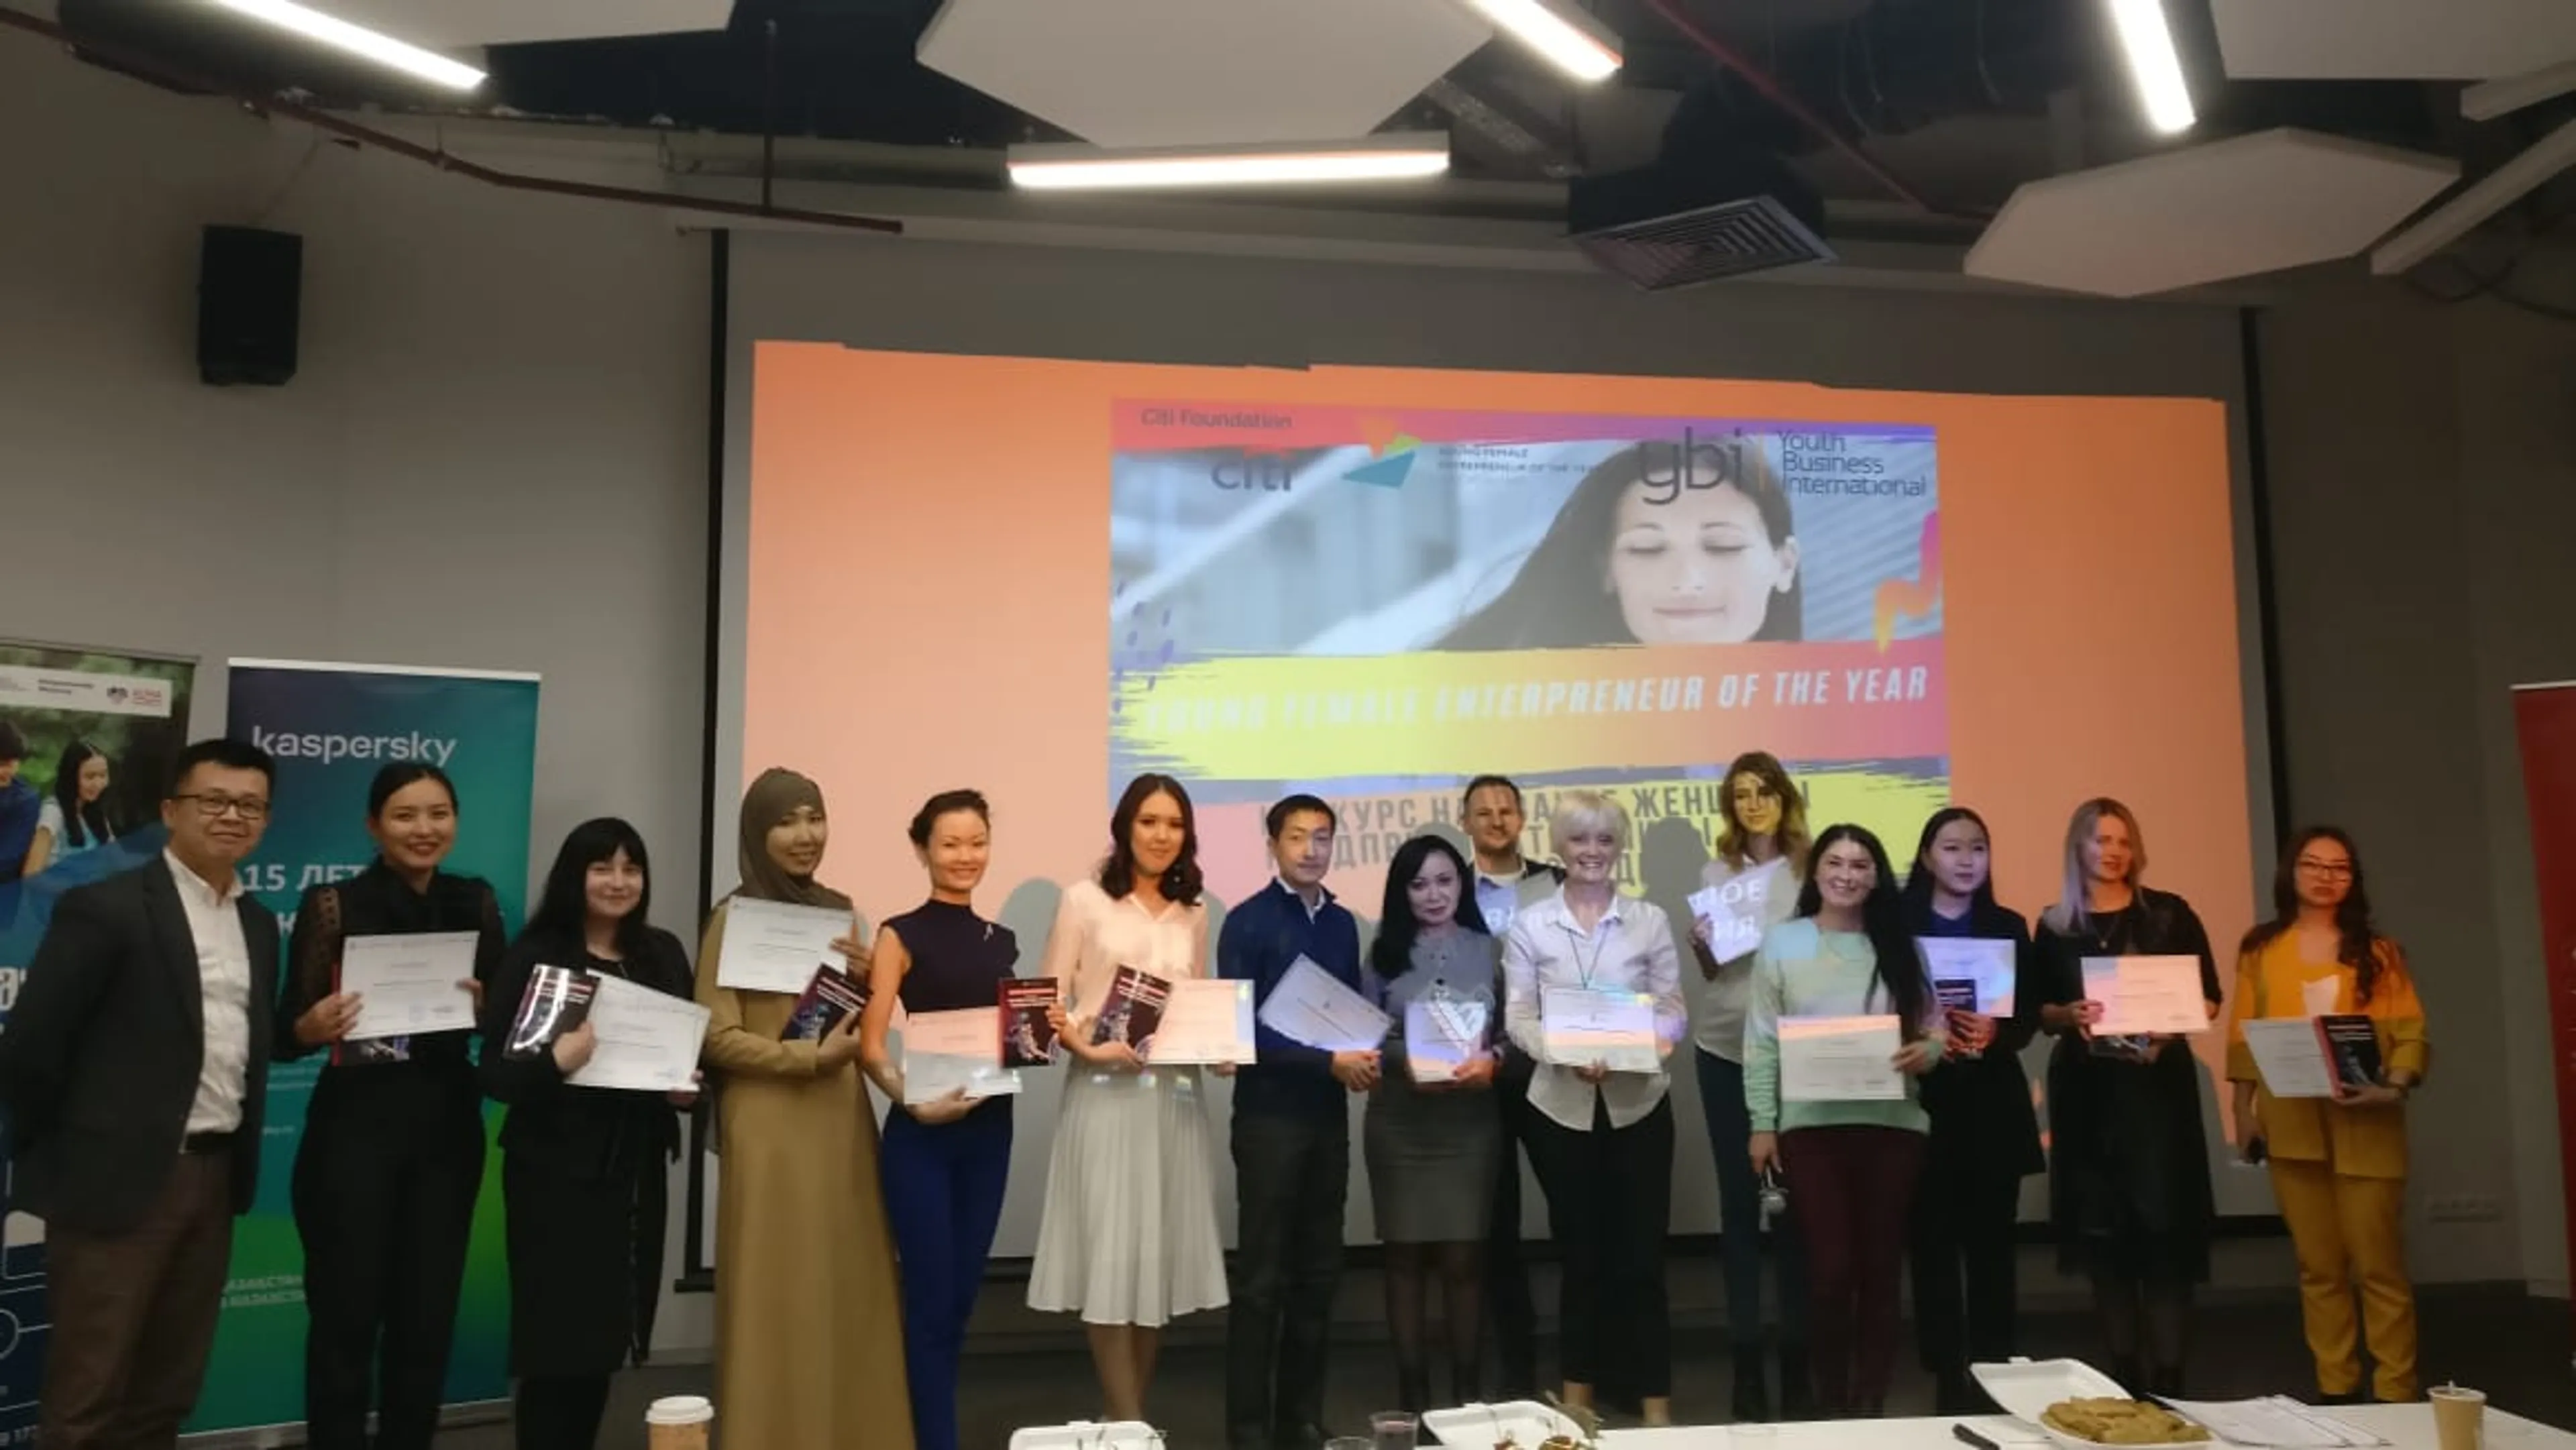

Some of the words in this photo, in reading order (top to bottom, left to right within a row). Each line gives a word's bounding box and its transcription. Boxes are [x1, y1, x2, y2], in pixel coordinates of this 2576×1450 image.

[1140, 408, 1174, 427] Citi
[1179, 409, 1296, 429] Foundation
[1776, 430, 1847, 453] Youth
[1210, 455, 1292, 492] citi
[1639, 426, 1744, 506] ybi
[1782, 449, 1884, 475] Business
[1782, 474, 1926, 497] International
[1283, 685, 1420, 729] FEMALE
[1718, 673, 1760, 709] OF
[1772, 671, 1831, 706] THE
[1845, 666, 1928, 703] YEAR
[252, 724, 458, 767] kaspersky
[244, 863, 286, 891] 15
